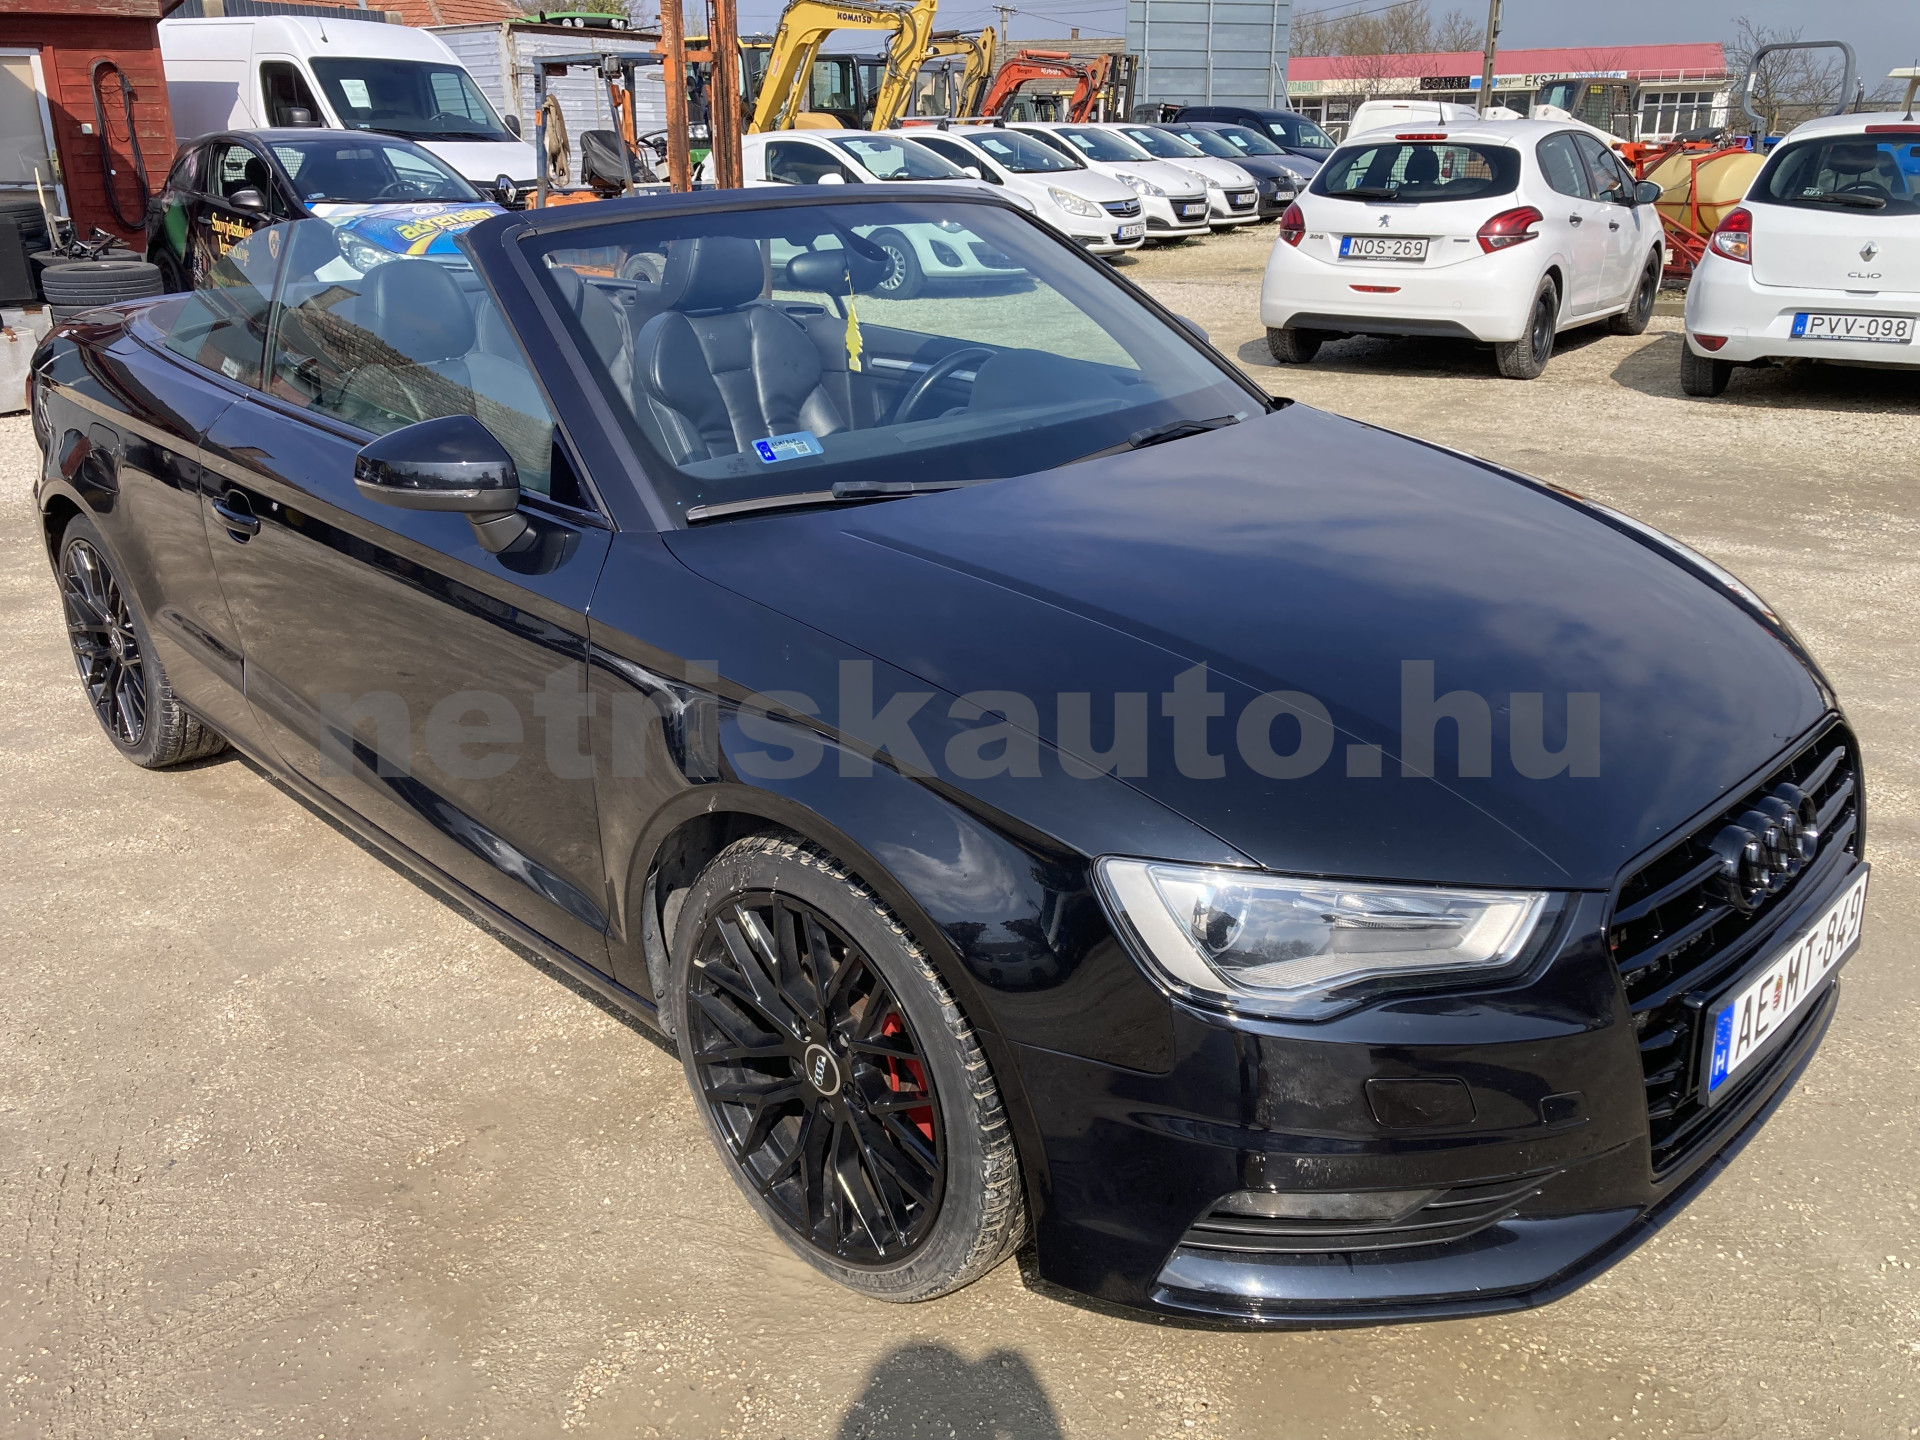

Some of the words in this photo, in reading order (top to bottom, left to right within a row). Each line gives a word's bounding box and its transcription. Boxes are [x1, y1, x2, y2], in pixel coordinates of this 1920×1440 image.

[837, 11, 872, 24] KOMATSU
[1352, 240, 1424, 256] NOS-269
[1809, 316, 1908, 337] PVV-098
[1714, 1049, 1726, 1076] H
[1734, 974, 1775, 1060] AE
[1782, 884, 1863, 1013] MT-849
